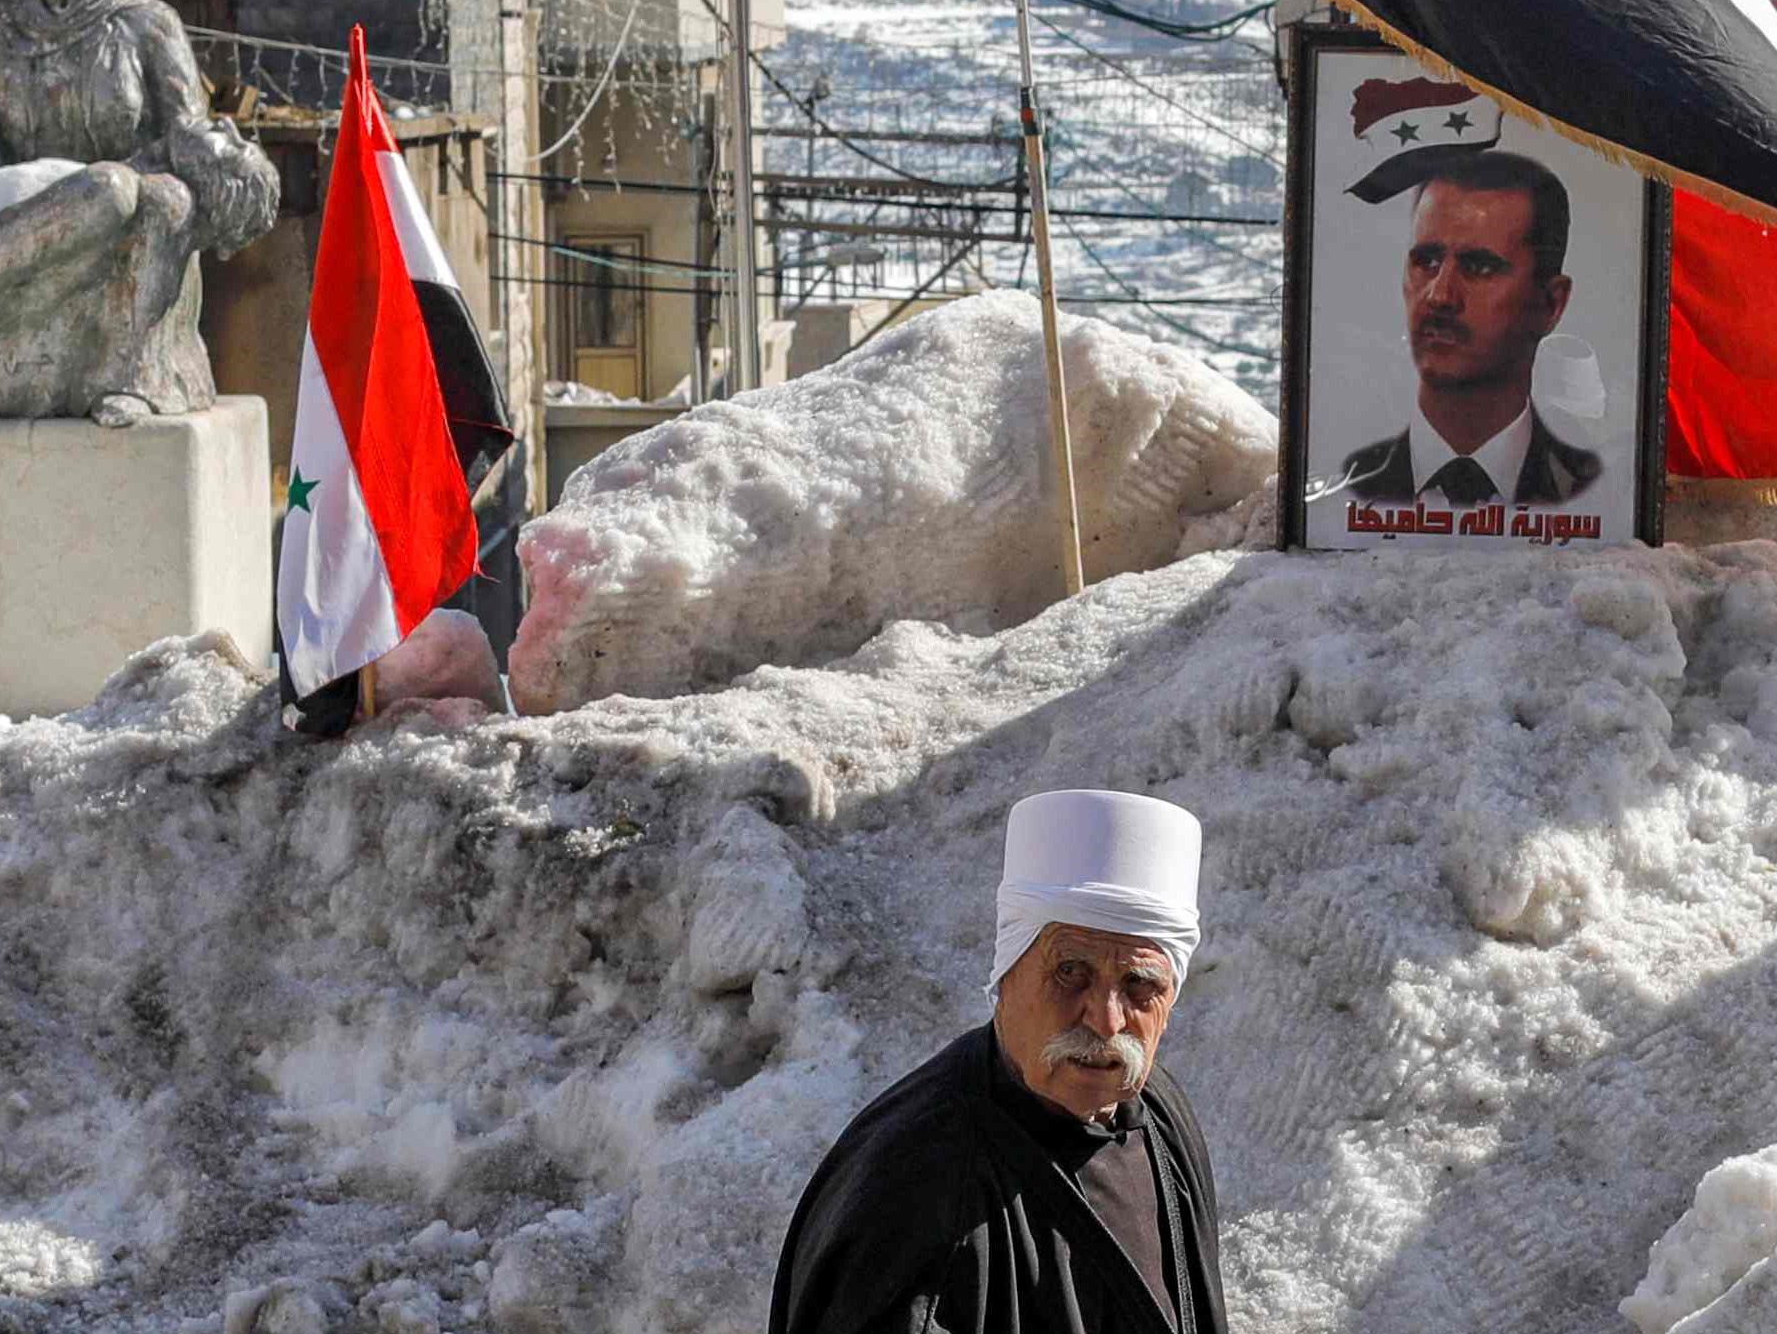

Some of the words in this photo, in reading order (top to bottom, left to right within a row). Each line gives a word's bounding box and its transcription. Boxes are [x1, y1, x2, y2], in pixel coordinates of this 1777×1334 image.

[1347, 500, 1453, 540] حاميها
[1458, 503, 1506, 536] الله
[1510, 505, 1601, 546] سورية
